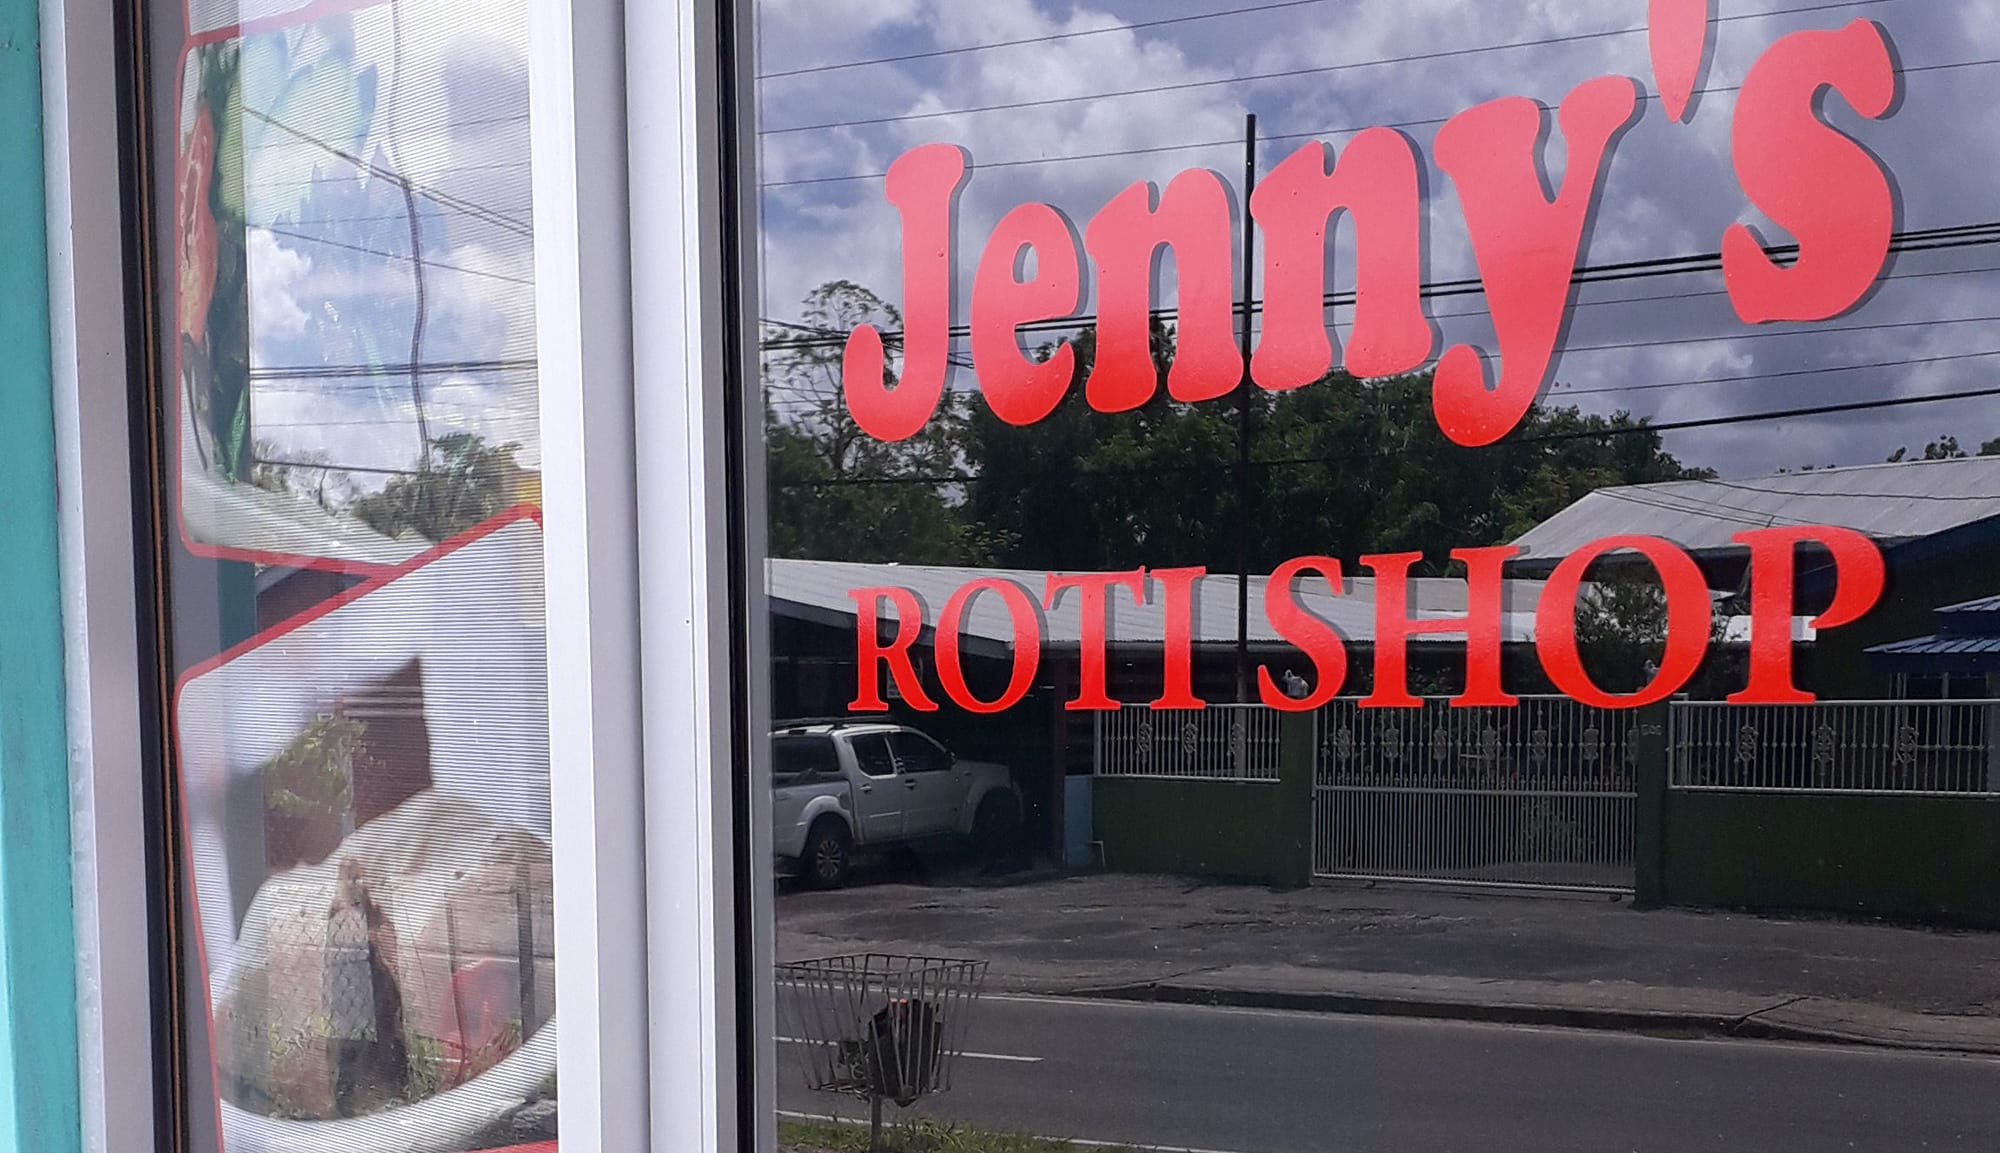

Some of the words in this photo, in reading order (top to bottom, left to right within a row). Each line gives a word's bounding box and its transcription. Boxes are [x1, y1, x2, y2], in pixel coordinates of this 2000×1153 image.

[843, 0, 1897, 447] Jenny's
[847, 565, 1207, 714] ROTI
[1257, 524, 1886, 712] SHOP
